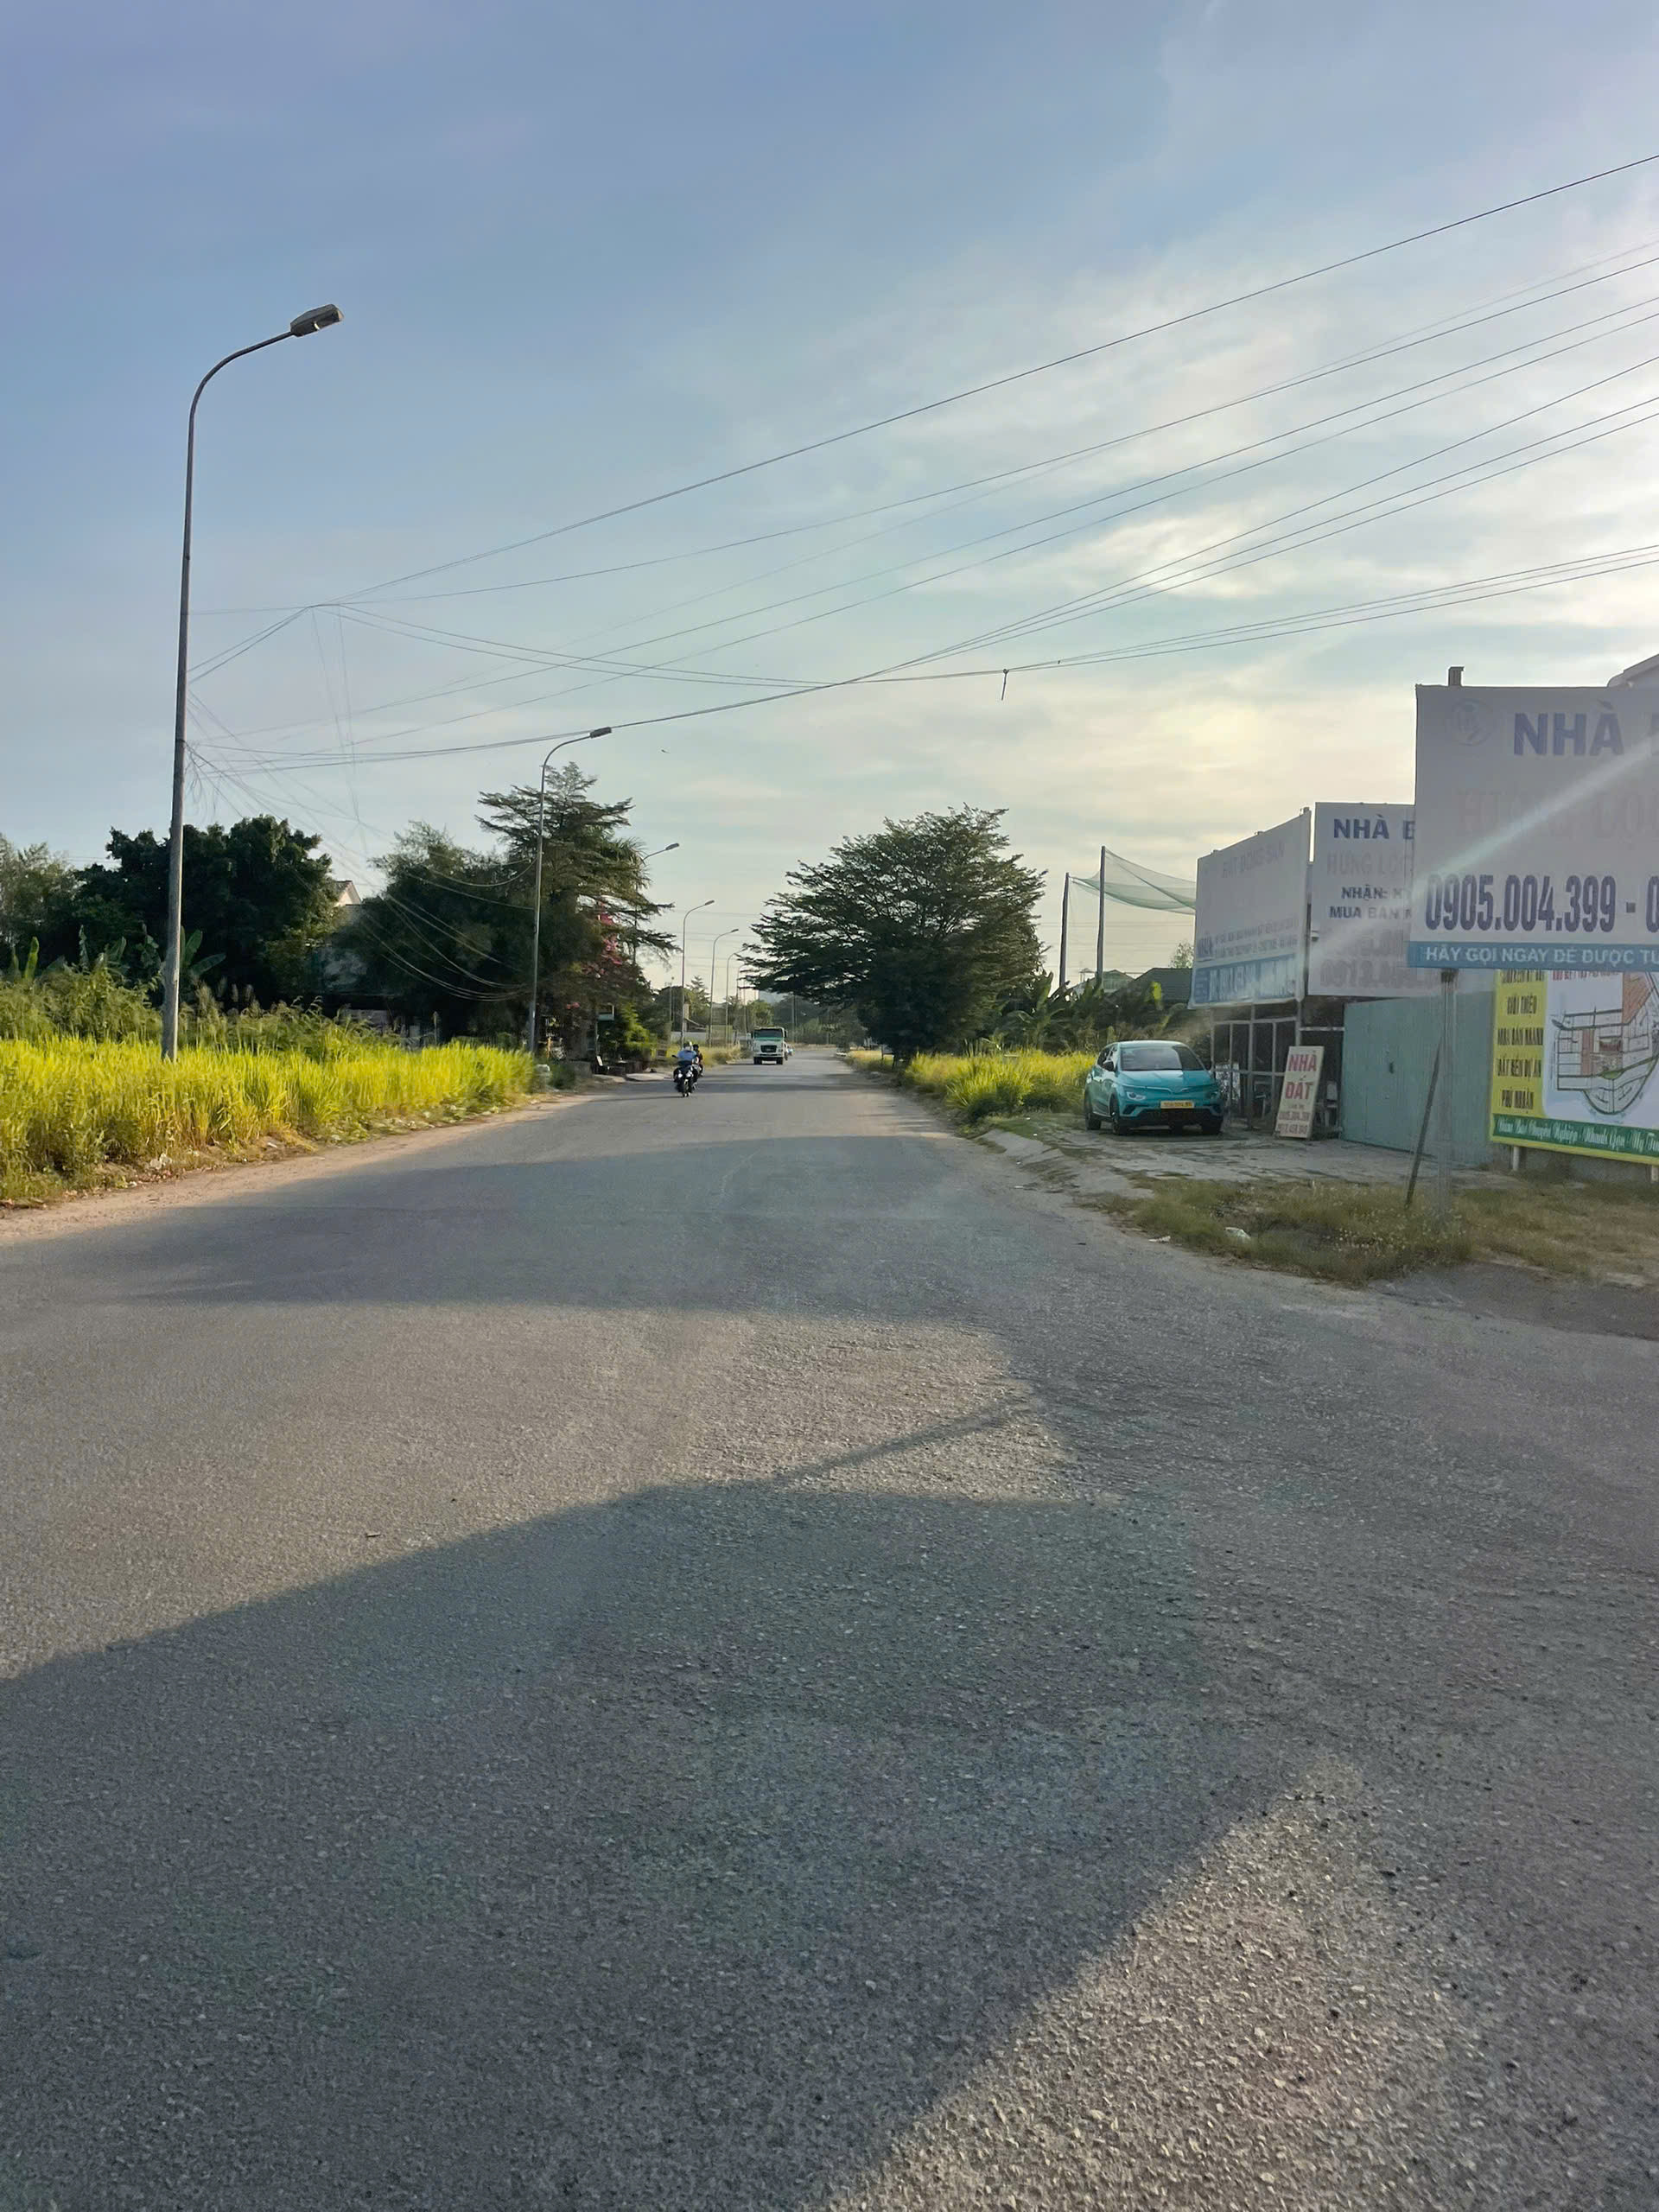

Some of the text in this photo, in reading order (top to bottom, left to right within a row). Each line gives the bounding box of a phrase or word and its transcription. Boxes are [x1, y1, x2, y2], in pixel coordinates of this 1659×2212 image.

[1514, 699, 1624, 757] NHÀ
[1333, 814, 1389, 840] NHÀ
[1425, 874, 1617, 933] 0905.004.399
[1501, 948, 1548, 963] NGAY
[1287, 1050, 1317, 1072] NHÀ
